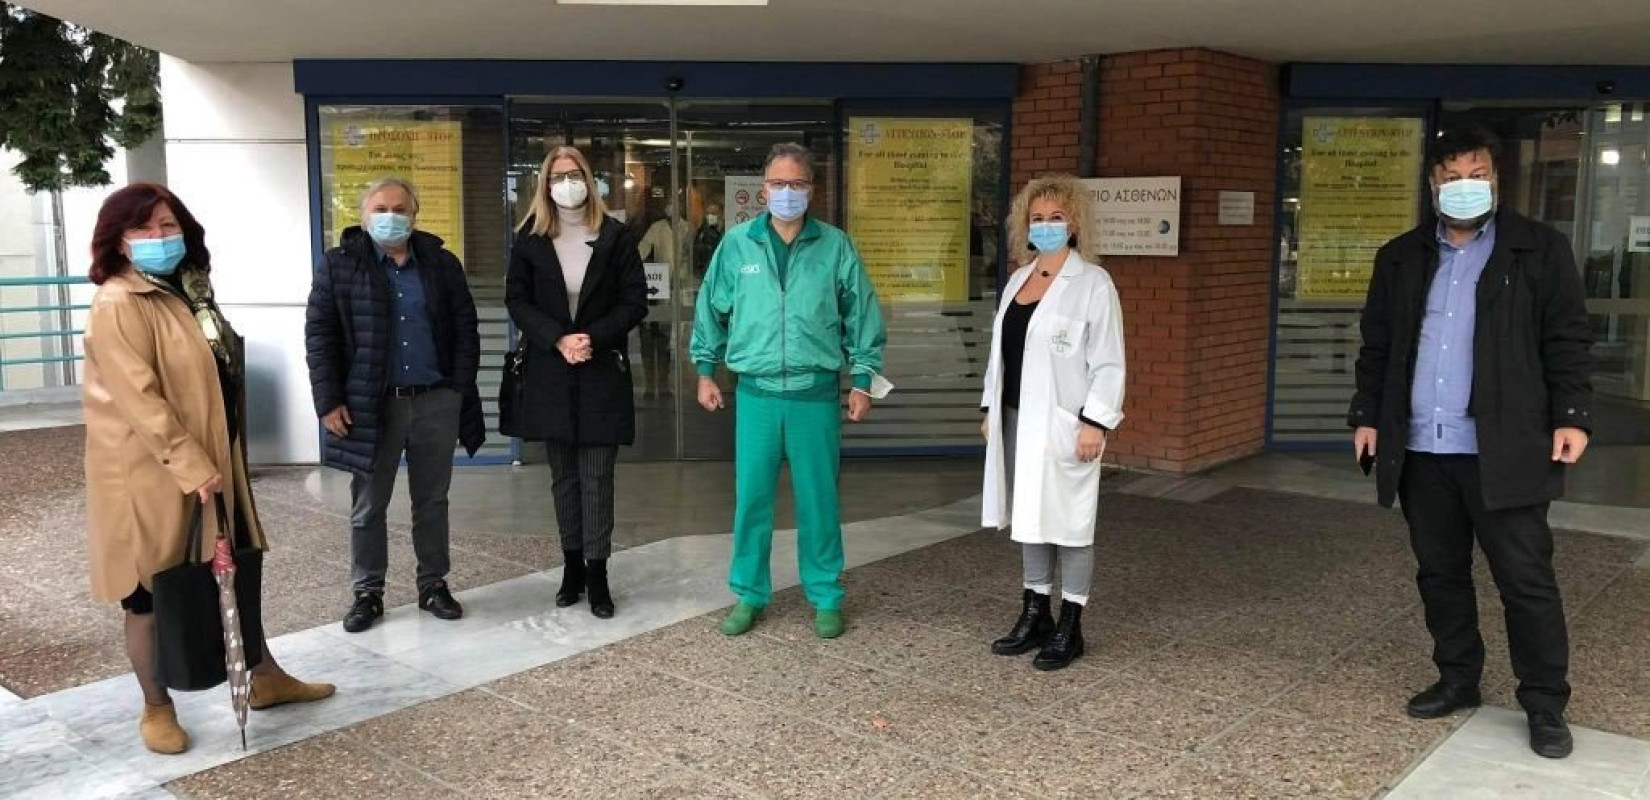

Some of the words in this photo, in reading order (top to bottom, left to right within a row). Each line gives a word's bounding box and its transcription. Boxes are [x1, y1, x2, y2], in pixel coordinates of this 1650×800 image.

[875, 150, 886, 158] all
[894, 161, 927, 171] Hospital
[1114, 188, 1177, 203] ΑΣΘΕΝΩΝ
